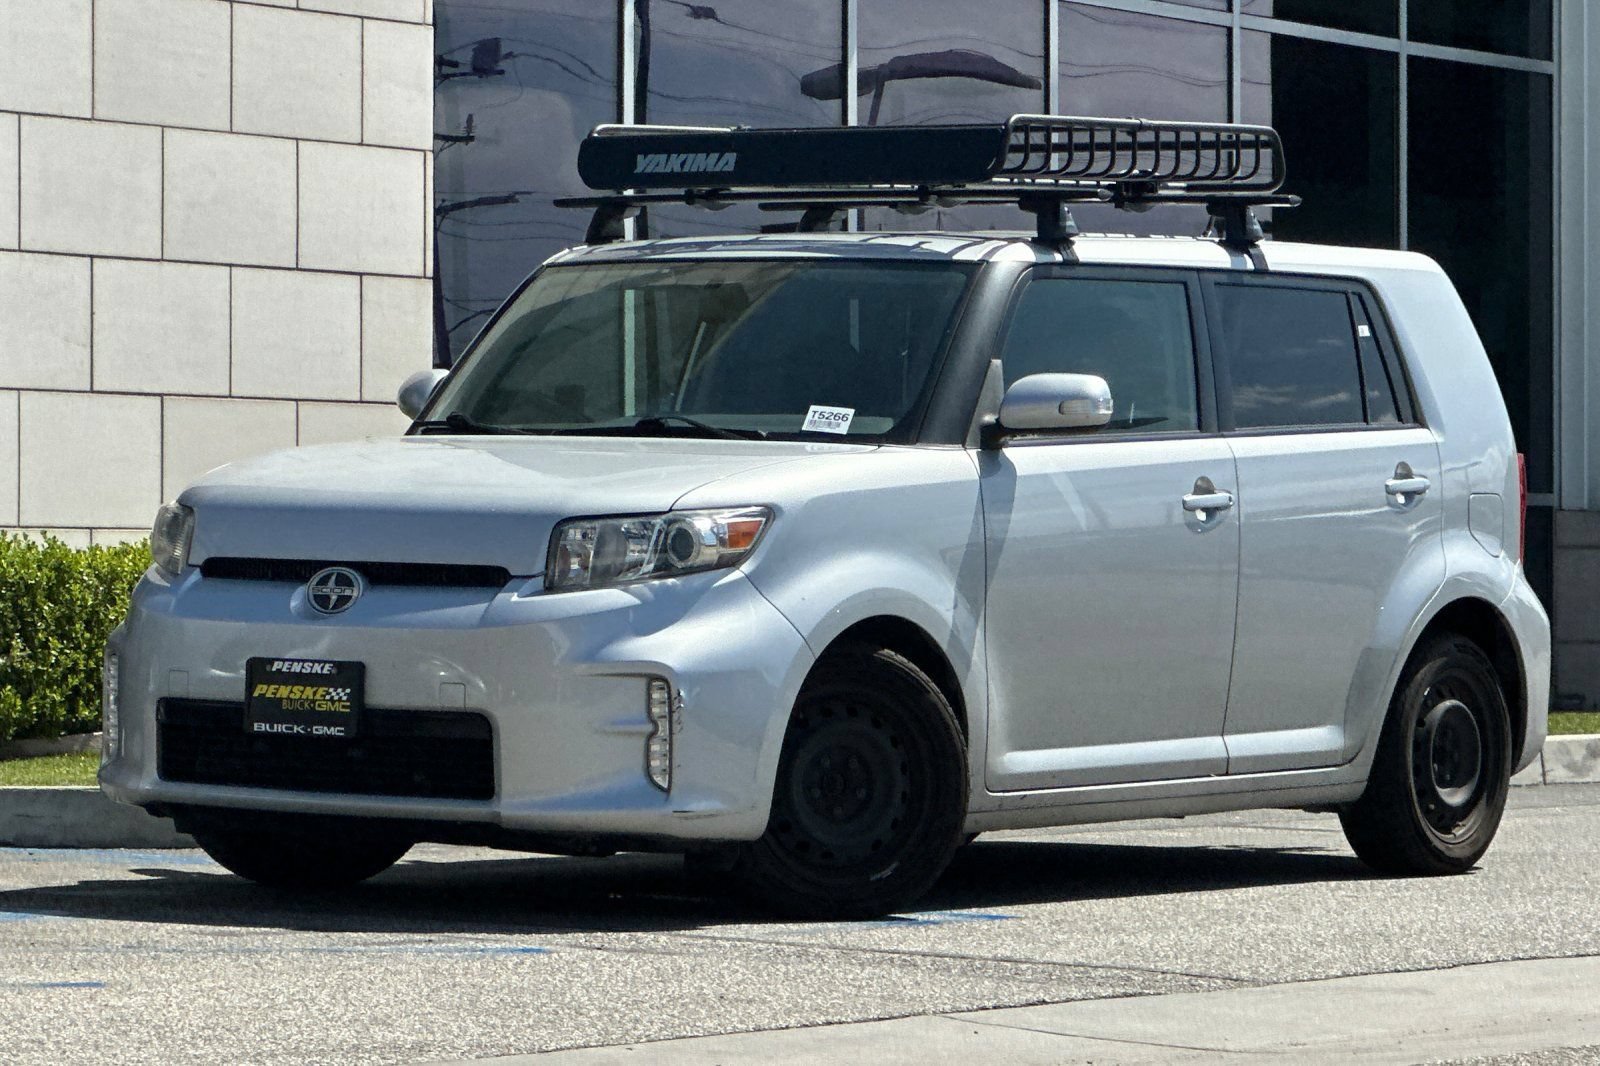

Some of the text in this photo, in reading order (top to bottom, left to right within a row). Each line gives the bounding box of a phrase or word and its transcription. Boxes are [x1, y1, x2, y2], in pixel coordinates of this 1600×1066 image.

[633, 152, 737, 173] YAKIMA
[811, 410, 850, 422] T5266
[271, 660, 334, 674] PENSKE
[252, 684, 330, 700] PENSKE
